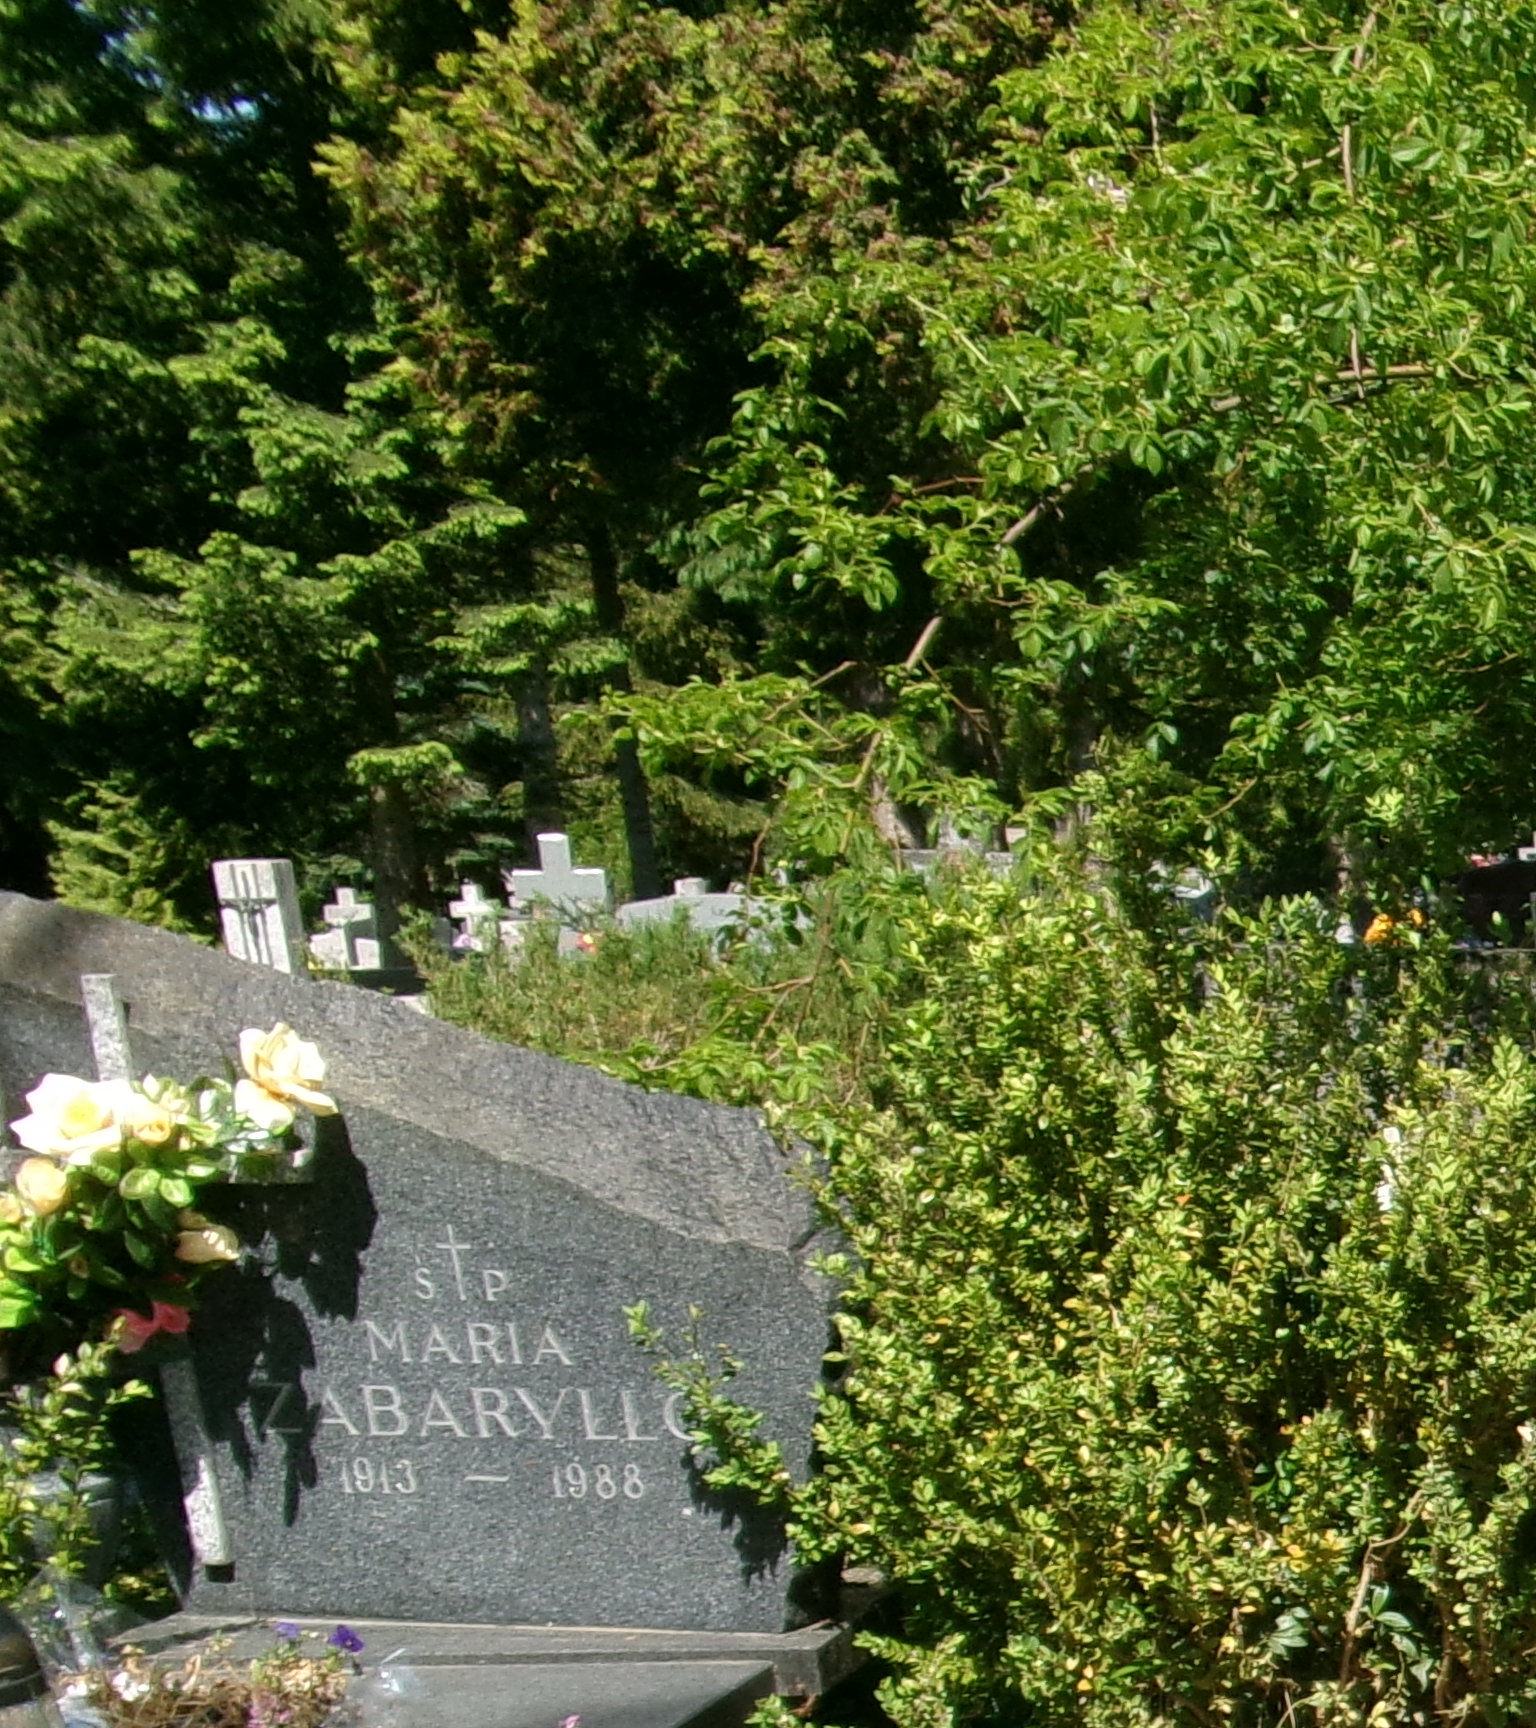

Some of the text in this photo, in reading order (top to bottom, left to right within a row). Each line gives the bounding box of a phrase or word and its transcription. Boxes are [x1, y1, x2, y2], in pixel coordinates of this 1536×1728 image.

[480, 1269, 511, 1302] P
[363, 1319, 574, 1367] MARIA
[340, 1456, 418, 1495] 1913
[551, 1462, 645, 1500] 1988
